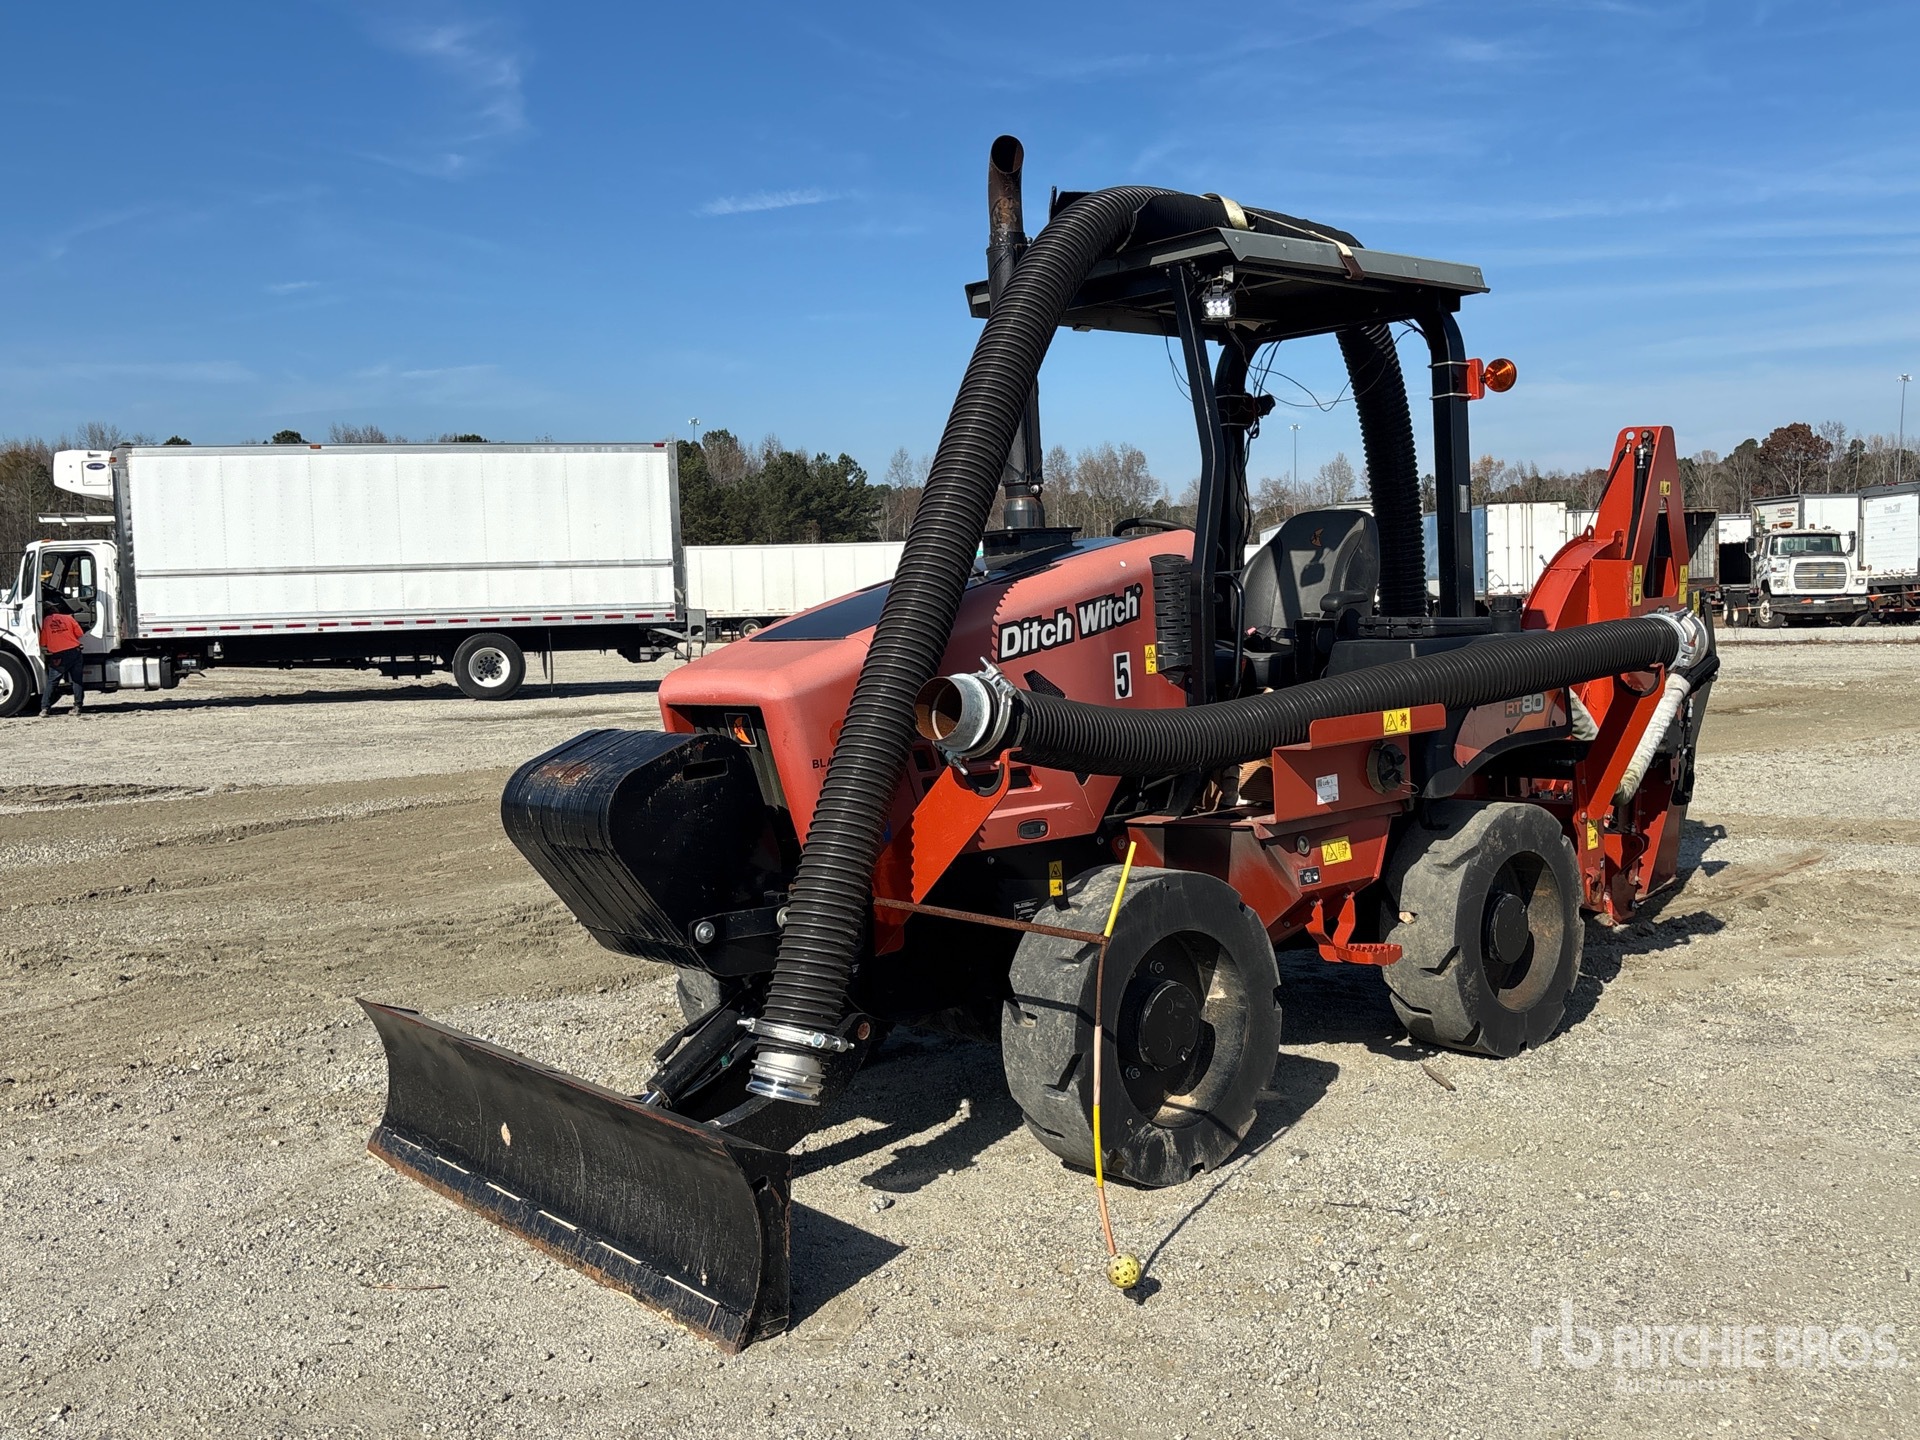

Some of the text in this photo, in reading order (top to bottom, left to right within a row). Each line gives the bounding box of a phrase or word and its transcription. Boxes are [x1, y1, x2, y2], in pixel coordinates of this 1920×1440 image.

[1000, 590, 1137, 659] Ditch Witch
[1116, 654, 1130, 698] 5
[1505, 693, 1545, 715] RT80
